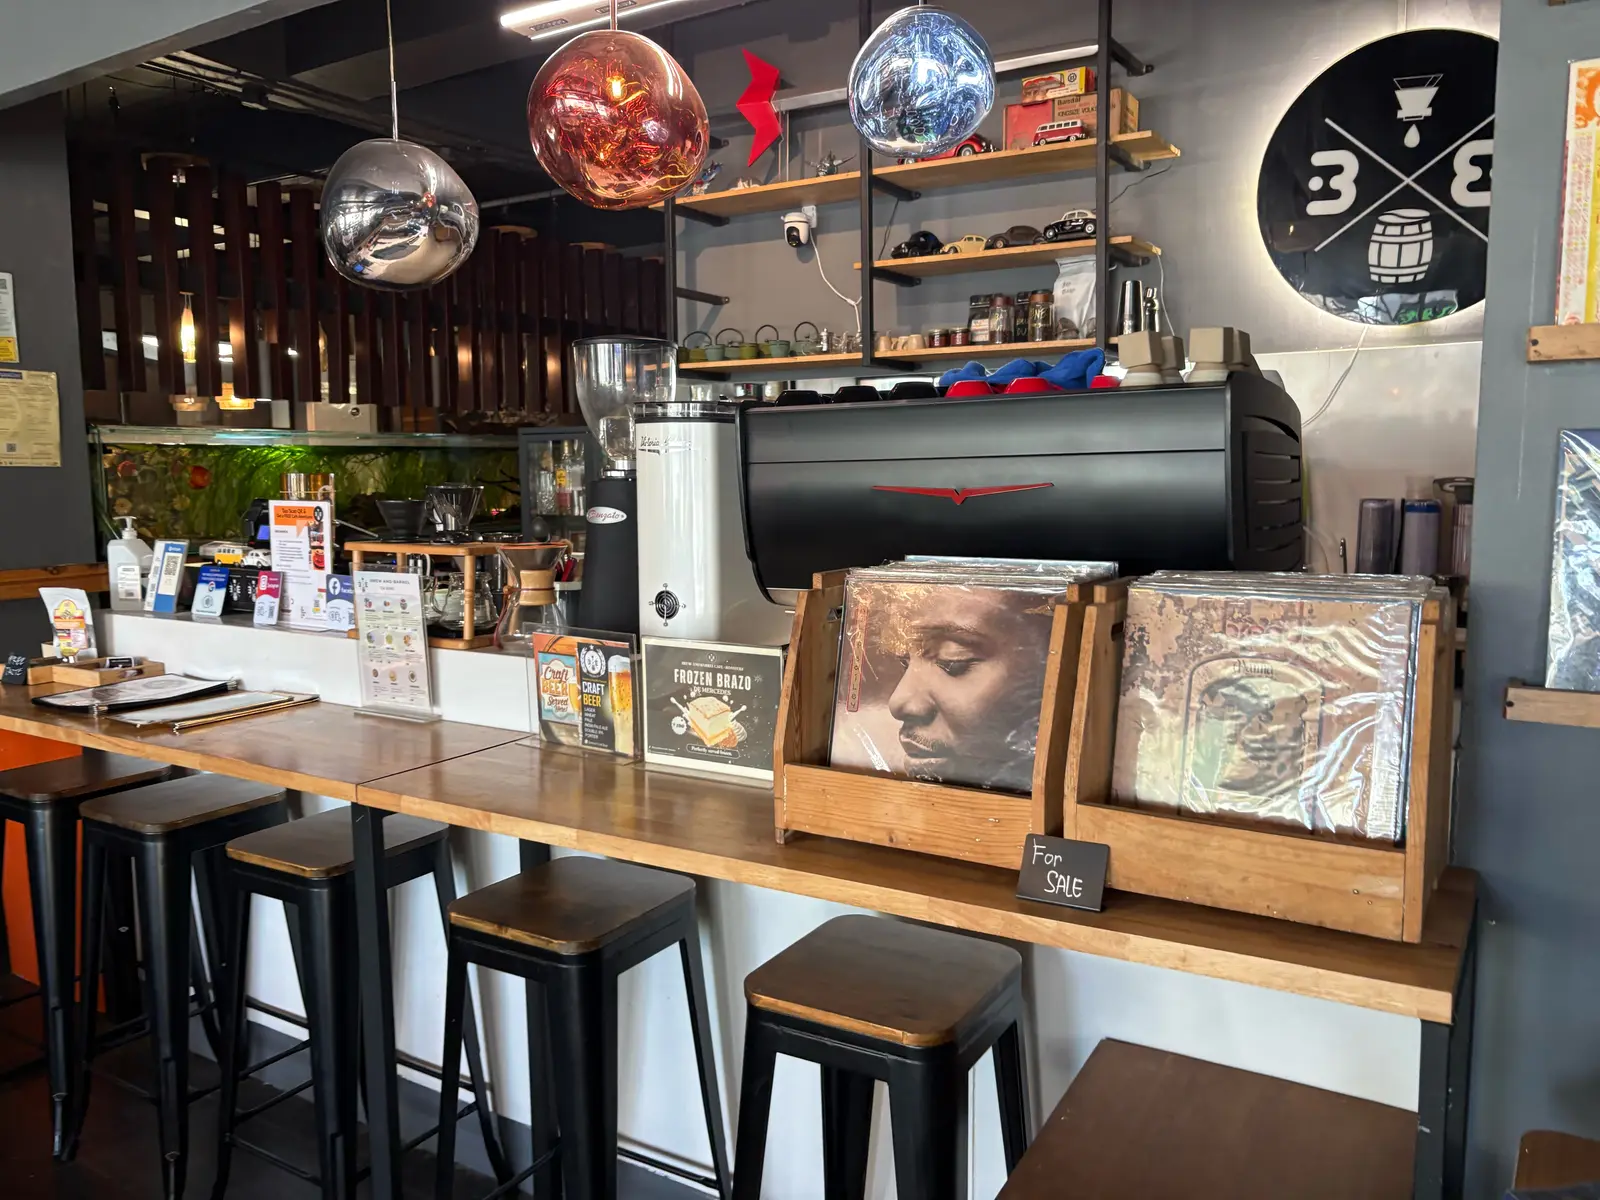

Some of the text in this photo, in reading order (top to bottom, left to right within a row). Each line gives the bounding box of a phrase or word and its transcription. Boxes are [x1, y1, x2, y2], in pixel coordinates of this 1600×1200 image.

[544, 666, 569, 684] Craft
[674, 668, 752, 691] FROZEN BRAZO
[542, 679, 569, 696] BEER
[582, 681, 605, 695] CRAFT
[702, 687, 732, 696] MERCEDES
[583, 694, 602, 707] BEER
[1032, 838, 1063, 867] For
[1043, 870, 1084, 899] SALE
